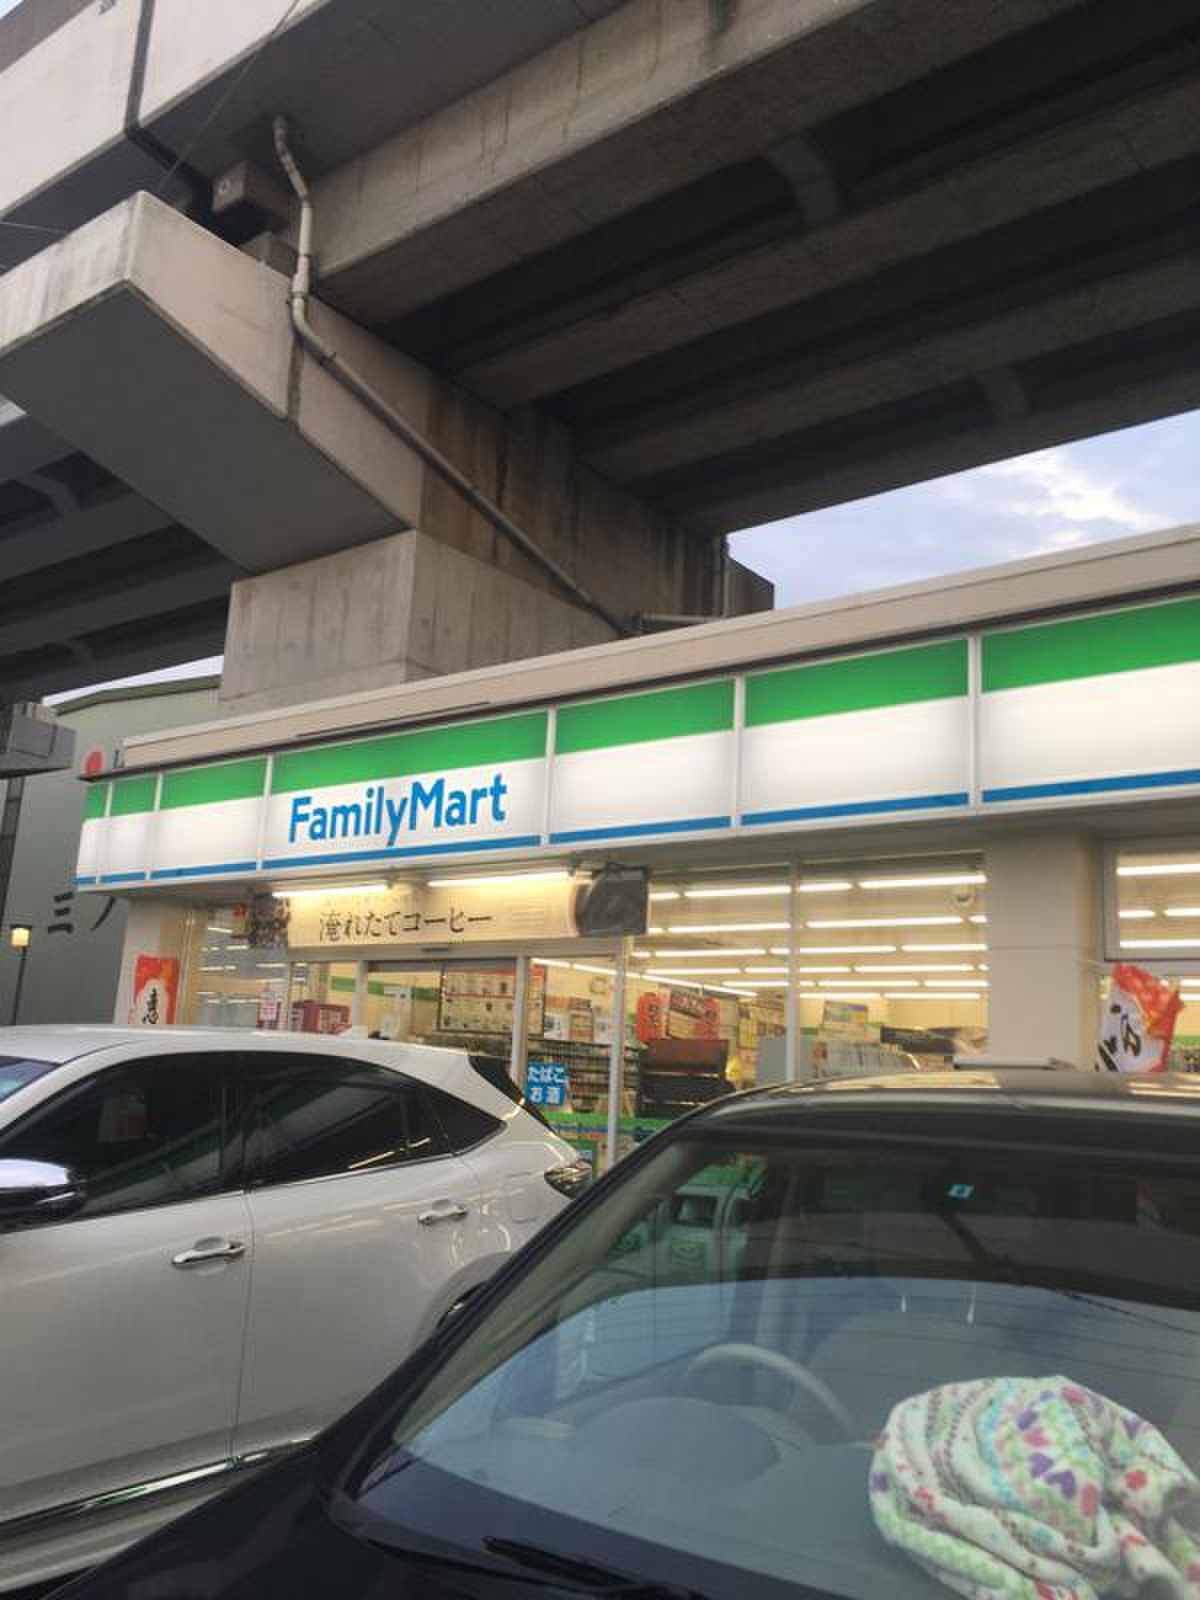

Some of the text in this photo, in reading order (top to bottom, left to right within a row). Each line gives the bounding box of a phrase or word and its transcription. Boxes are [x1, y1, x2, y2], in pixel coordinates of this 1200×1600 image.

[289, 773, 508, 847] FamilyMart
[528, 1065, 566, 1083] たばこ
